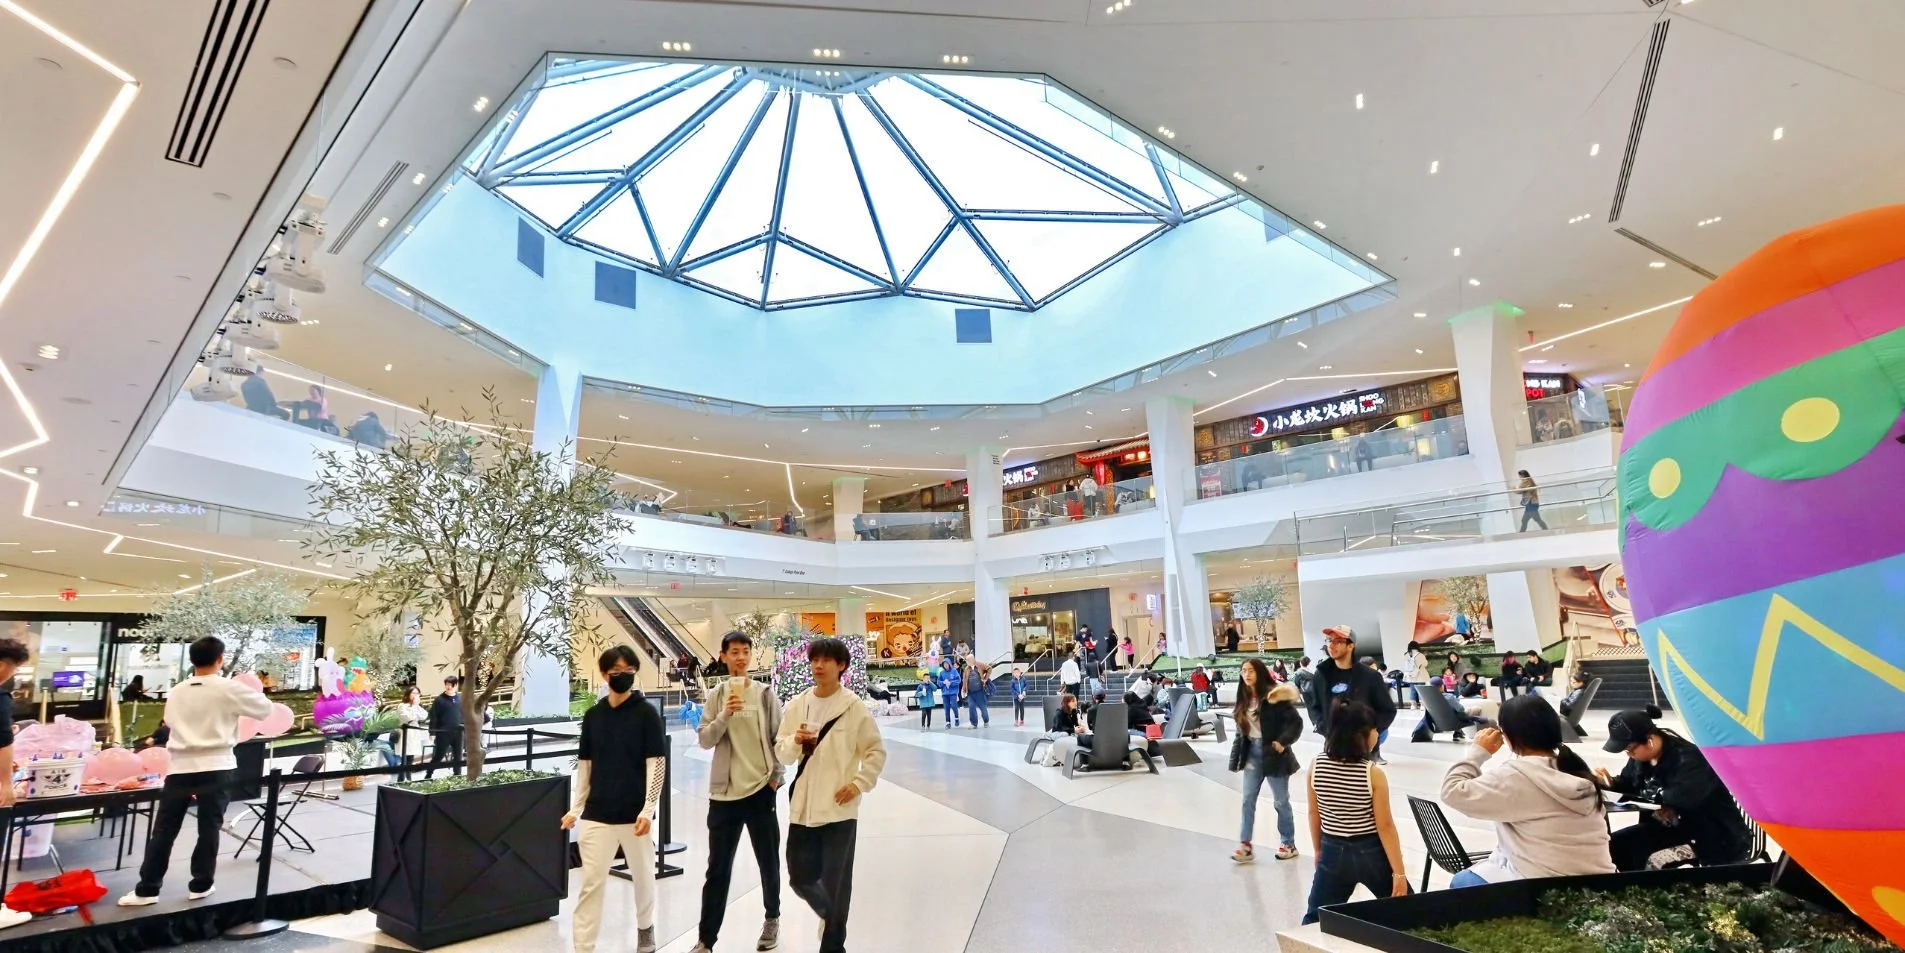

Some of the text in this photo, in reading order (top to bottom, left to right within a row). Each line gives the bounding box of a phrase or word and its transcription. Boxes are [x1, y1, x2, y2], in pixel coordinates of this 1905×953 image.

[1526, 389, 1544, 398] POT
[1272, 399, 1358, 430] 小龙坎火锅
